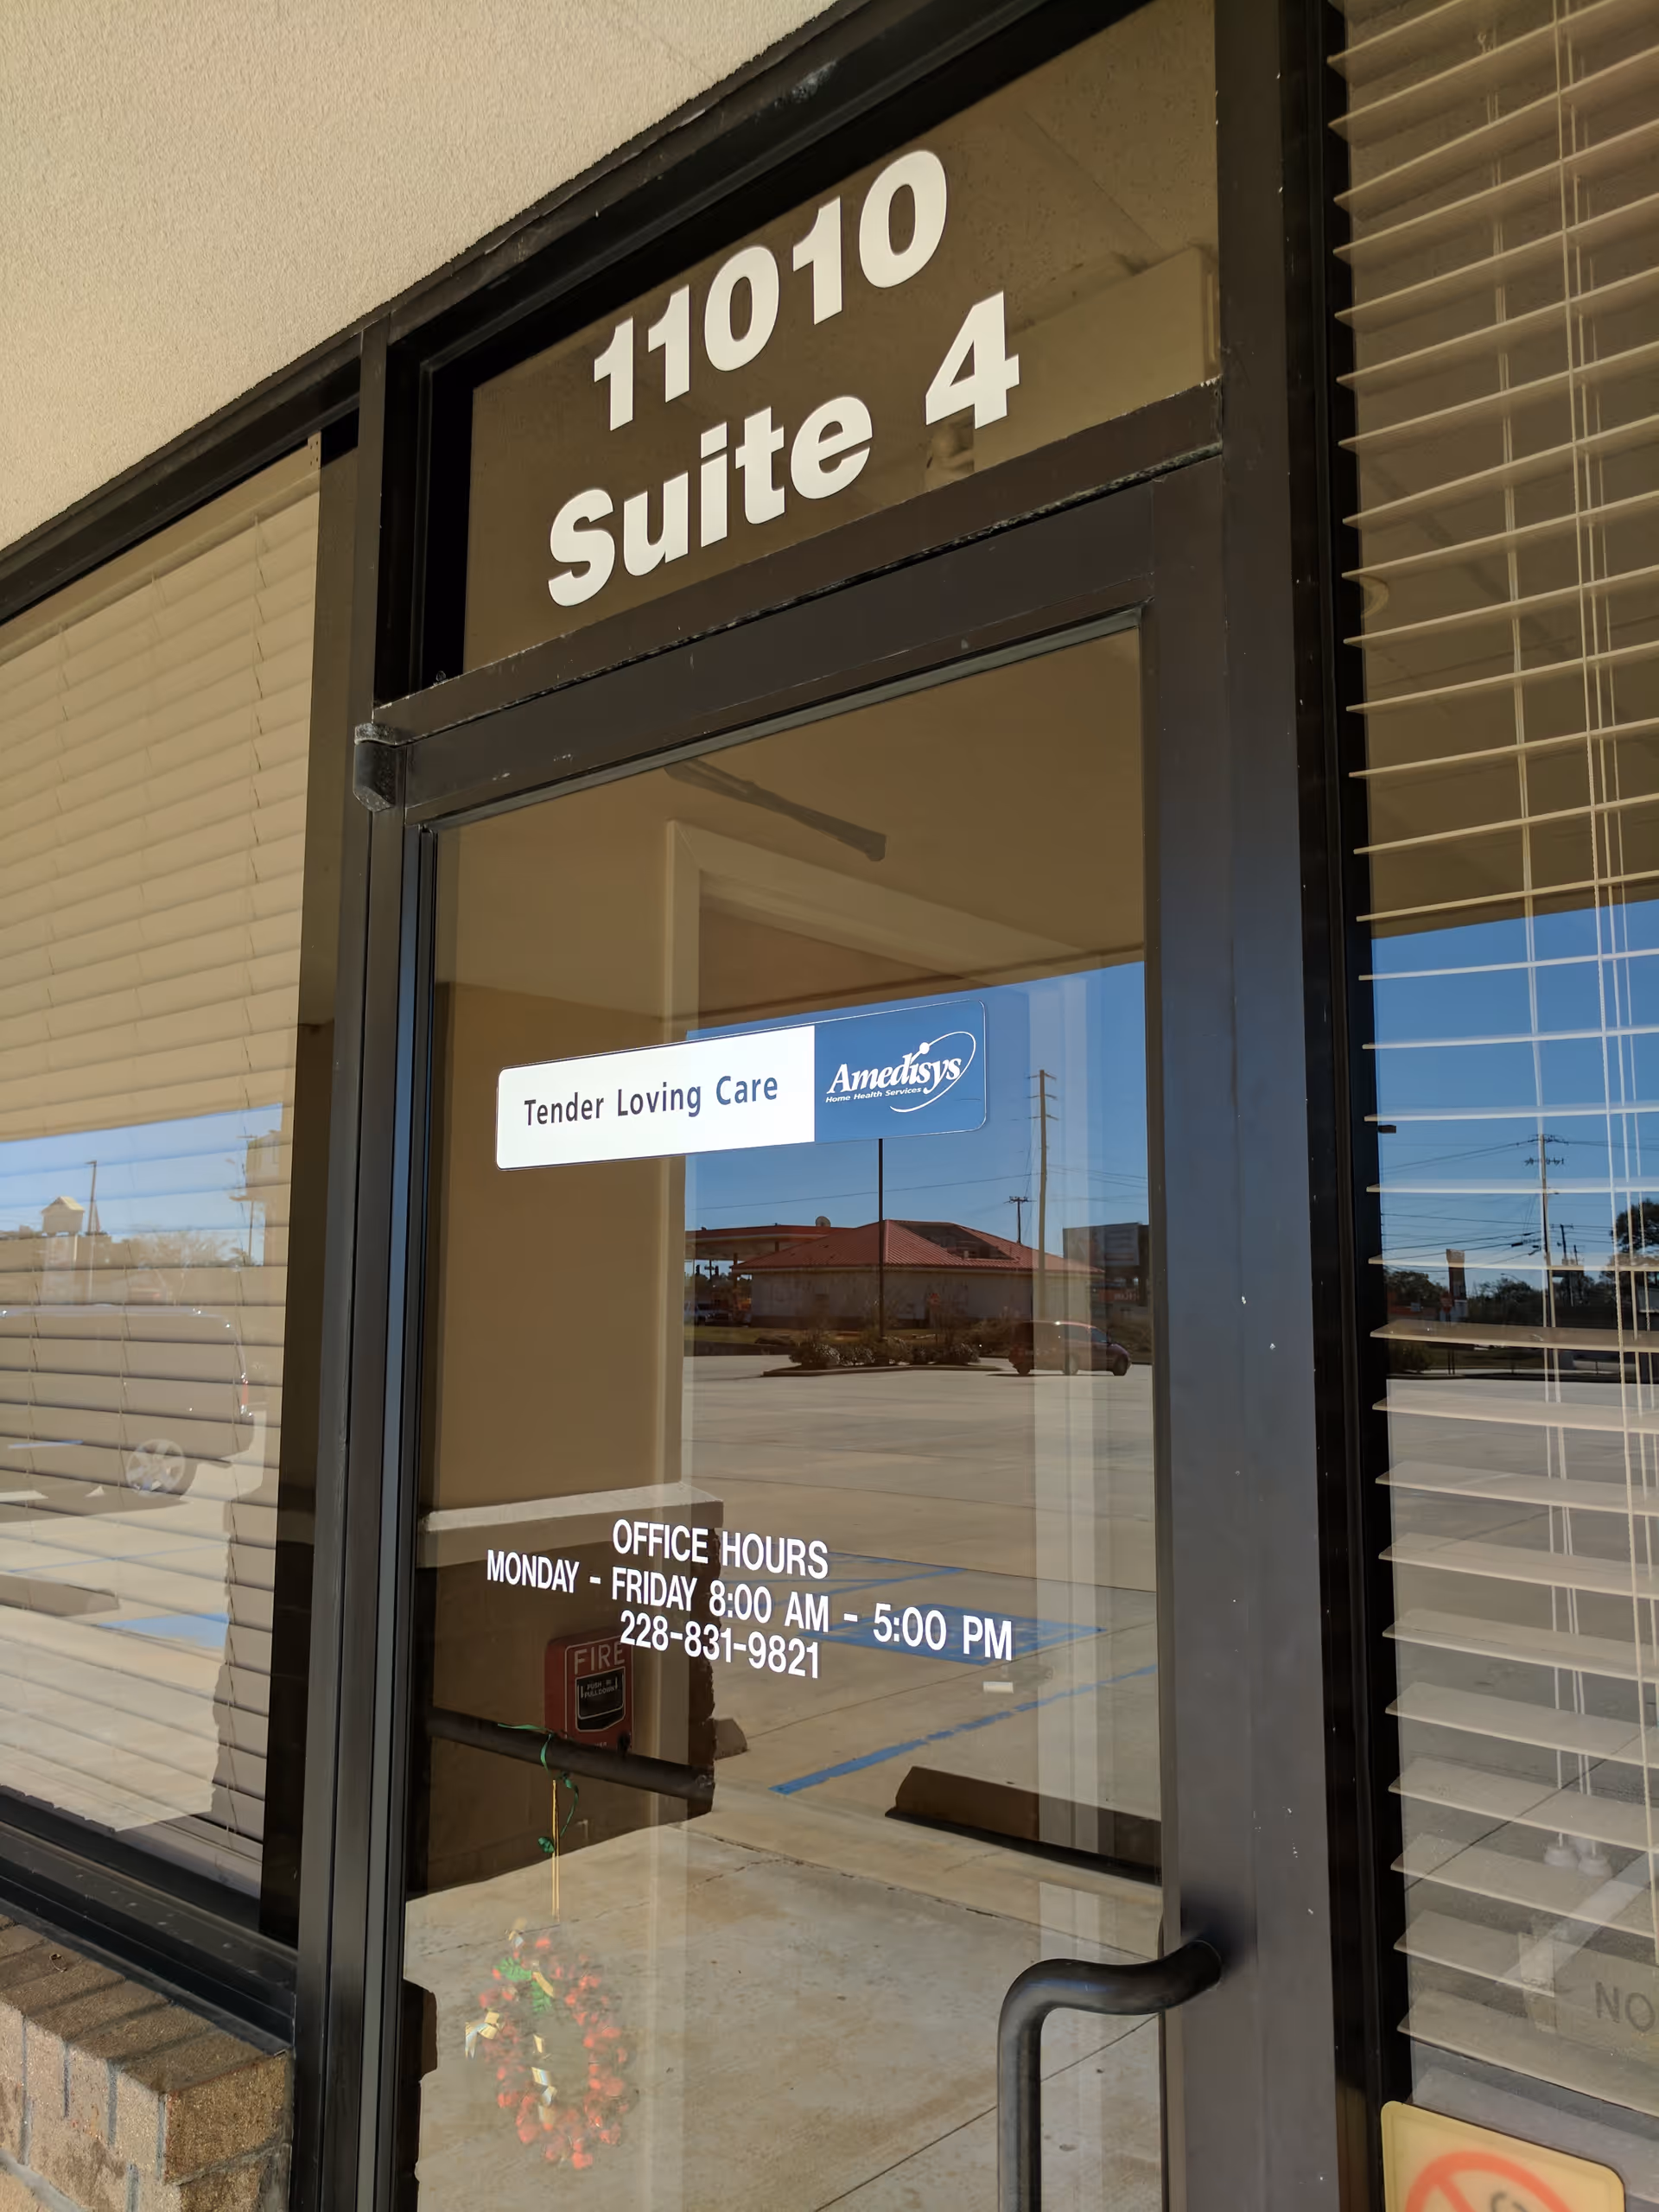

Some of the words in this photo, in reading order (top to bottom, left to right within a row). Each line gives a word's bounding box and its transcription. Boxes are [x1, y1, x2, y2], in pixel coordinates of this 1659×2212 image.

[594, 149, 948, 432] 11010
[547, 394, 874, 607] Suite
[925, 289, 1020, 430] 4
[524, 1091, 605, 1127] Tender
[616, 1080, 702, 1119] Loving
[715, 1071, 779, 1107] Care
[825, 1095, 851, 1103] Home
[853, 1090, 883, 1100] Health
[885, 1087, 922, 1096] Services
[826, 1052, 963, 1095] Amedisys
[612, 1518, 709, 1565] OFFICE
[721, 1530, 830, 1580] HOURS
[486, 1548, 580, 1594] MONDAY
[589, 1576, 601, 1585] -
[612, 1566, 699, 1612] FRIDAY
[709, 1579, 773, 1624] 8:00
[784, 1590, 830, 1634] AM
[843, 1613, 858, 1623] -
[873, 1602, 947, 1651] 5:00
[963, 1614, 1012, 1662] PM
[574, 1643, 626, 1675] FIRE
[620, 1609, 823, 1680] 228-831-9821
[1595, 1980, 1656, 2032] NO
